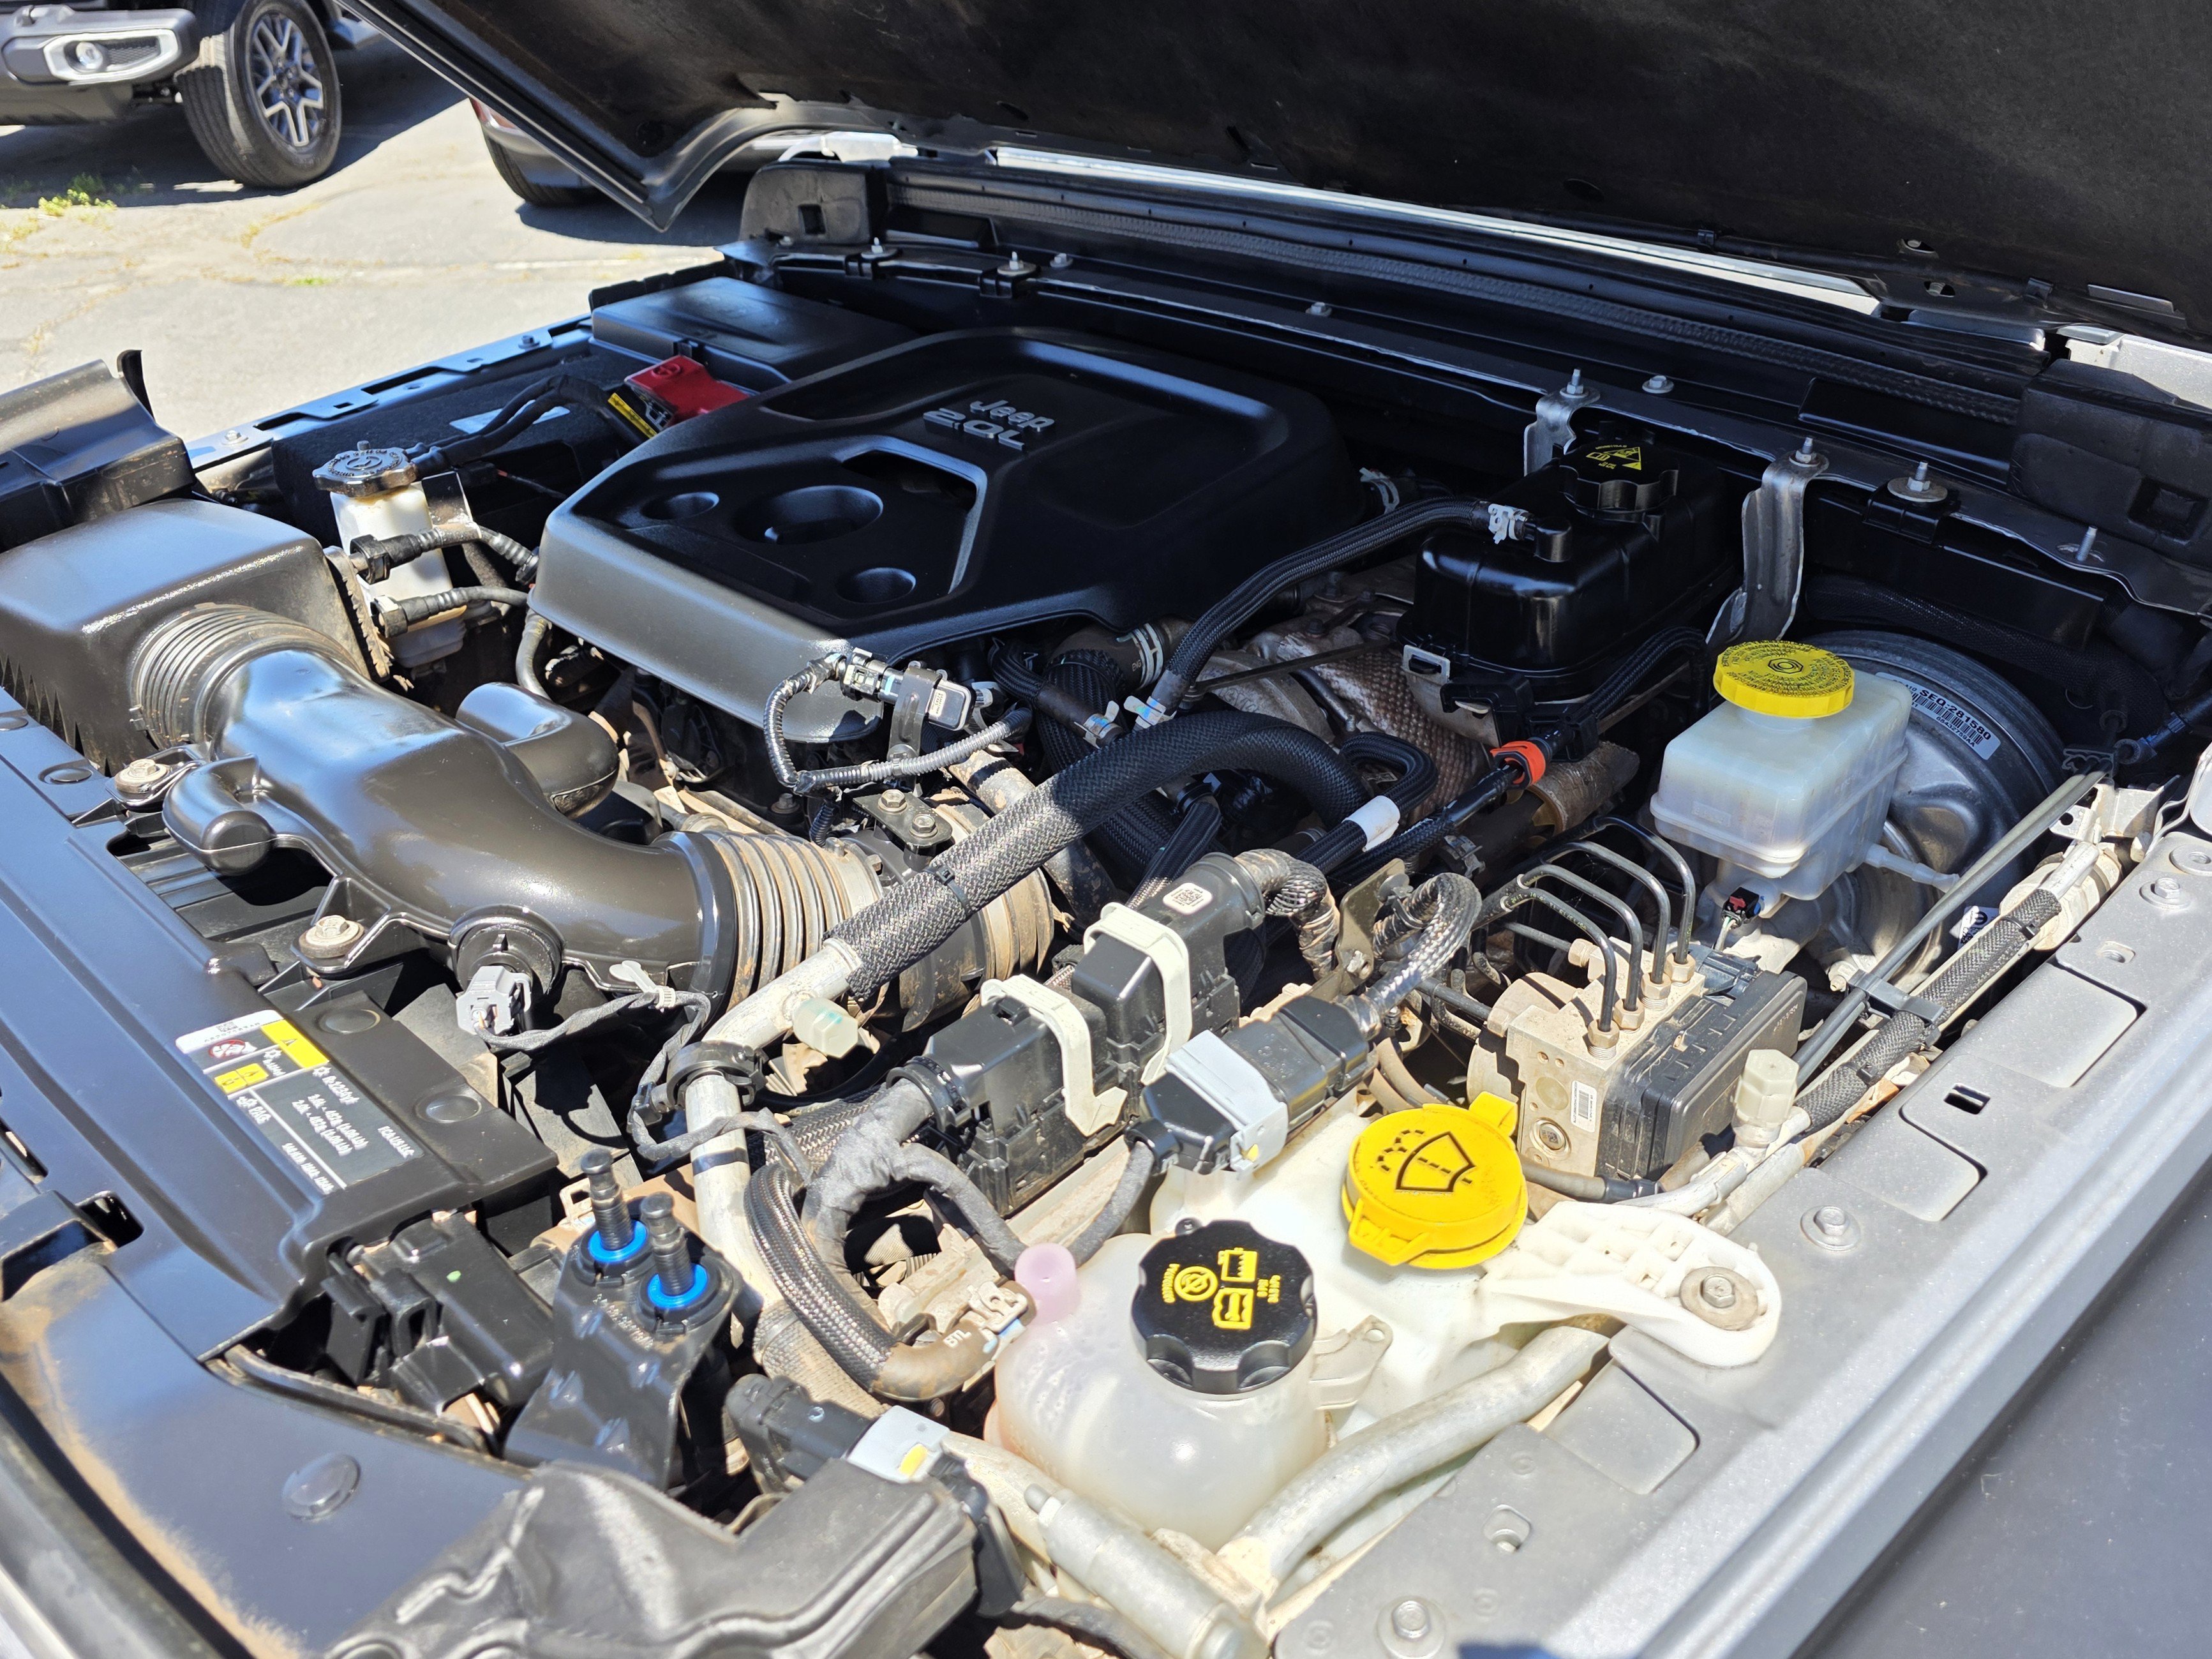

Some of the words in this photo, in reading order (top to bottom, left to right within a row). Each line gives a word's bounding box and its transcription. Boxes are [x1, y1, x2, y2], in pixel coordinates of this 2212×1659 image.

[923, 407, 1025, 451] 2.0L
[969, 400, 1055, 432] Jeep
[1919, 689, 1992, 741] SEQ:281580
[248, 1106, 272, 1124] PAG
[378, 1126, 396, 1140] FCA
[387, 1136, 405, 1148] US
[943, 1329, 972, 1348] BTL
